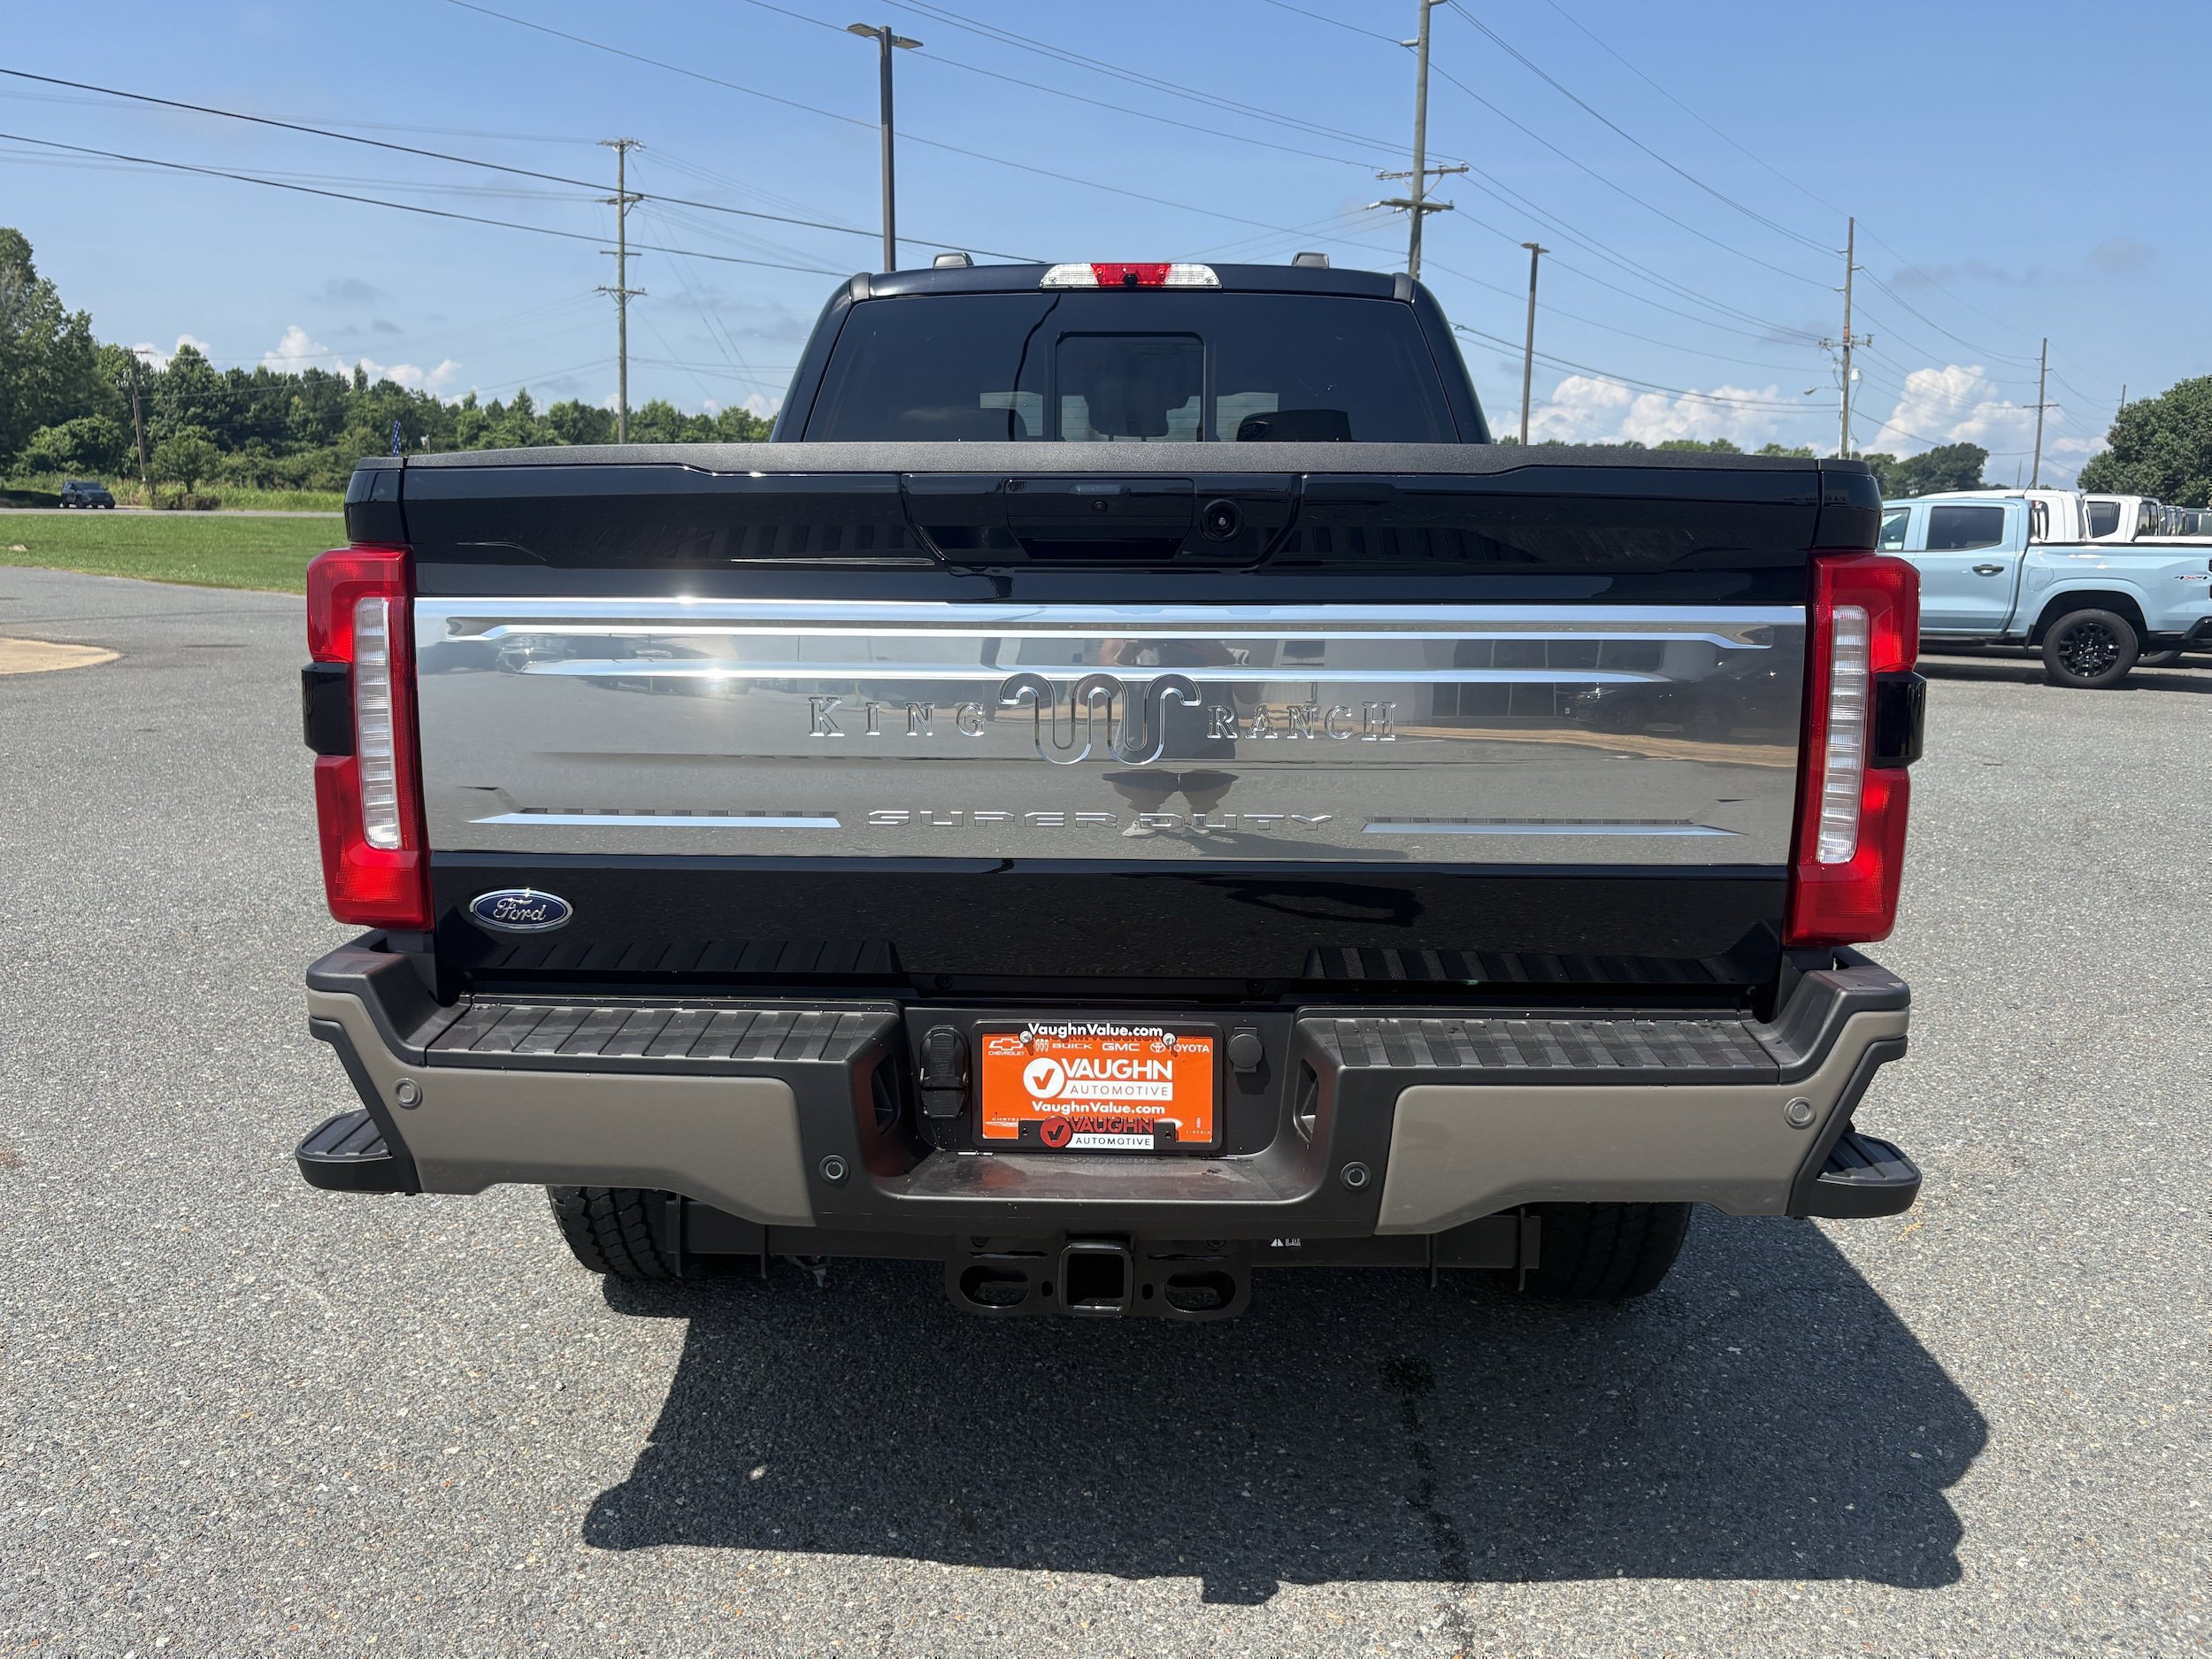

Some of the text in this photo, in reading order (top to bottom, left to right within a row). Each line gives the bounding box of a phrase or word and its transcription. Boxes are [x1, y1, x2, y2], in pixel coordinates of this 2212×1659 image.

[808, 696, 1397, 741] KING RANCH
[868, 810, 1333, 831] SUPER DUTY
[493, 897, 547, 921] Ford
[1027, 1022, 1164, 1040] VaughnValue.com
[1102, 1042, 1141, 1052] GMC
[1061, 1057, 1173, 1080] VAUGHN
[1069, 1084, 1169, 1097] AUTOMOTIVE
[1031, 1100, 1165, 1115] VaughnValue.com
[1067, 1116, 1155, 1134] VAUGHN
[1075, 1136, 1151, 1146] AUTOMOTIVE
